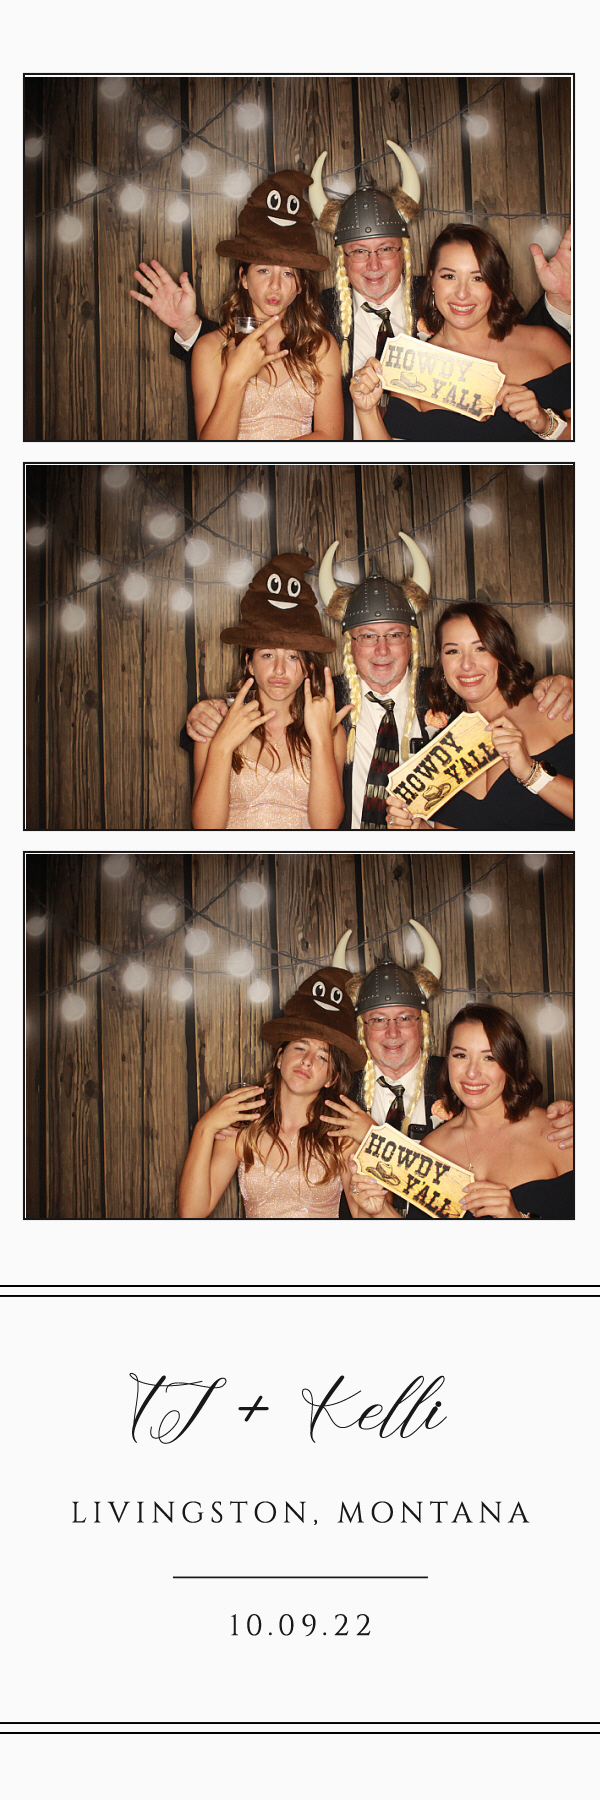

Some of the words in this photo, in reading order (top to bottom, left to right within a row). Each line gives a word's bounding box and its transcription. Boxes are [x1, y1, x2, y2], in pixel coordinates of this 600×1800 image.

[385, 345, 473, 383] HOWDY
[430, 377, 483, 416] Y'ALL
[392, 731, 463, 806] HOWDY
[364, 1132, 450, 1186] HOWDY
